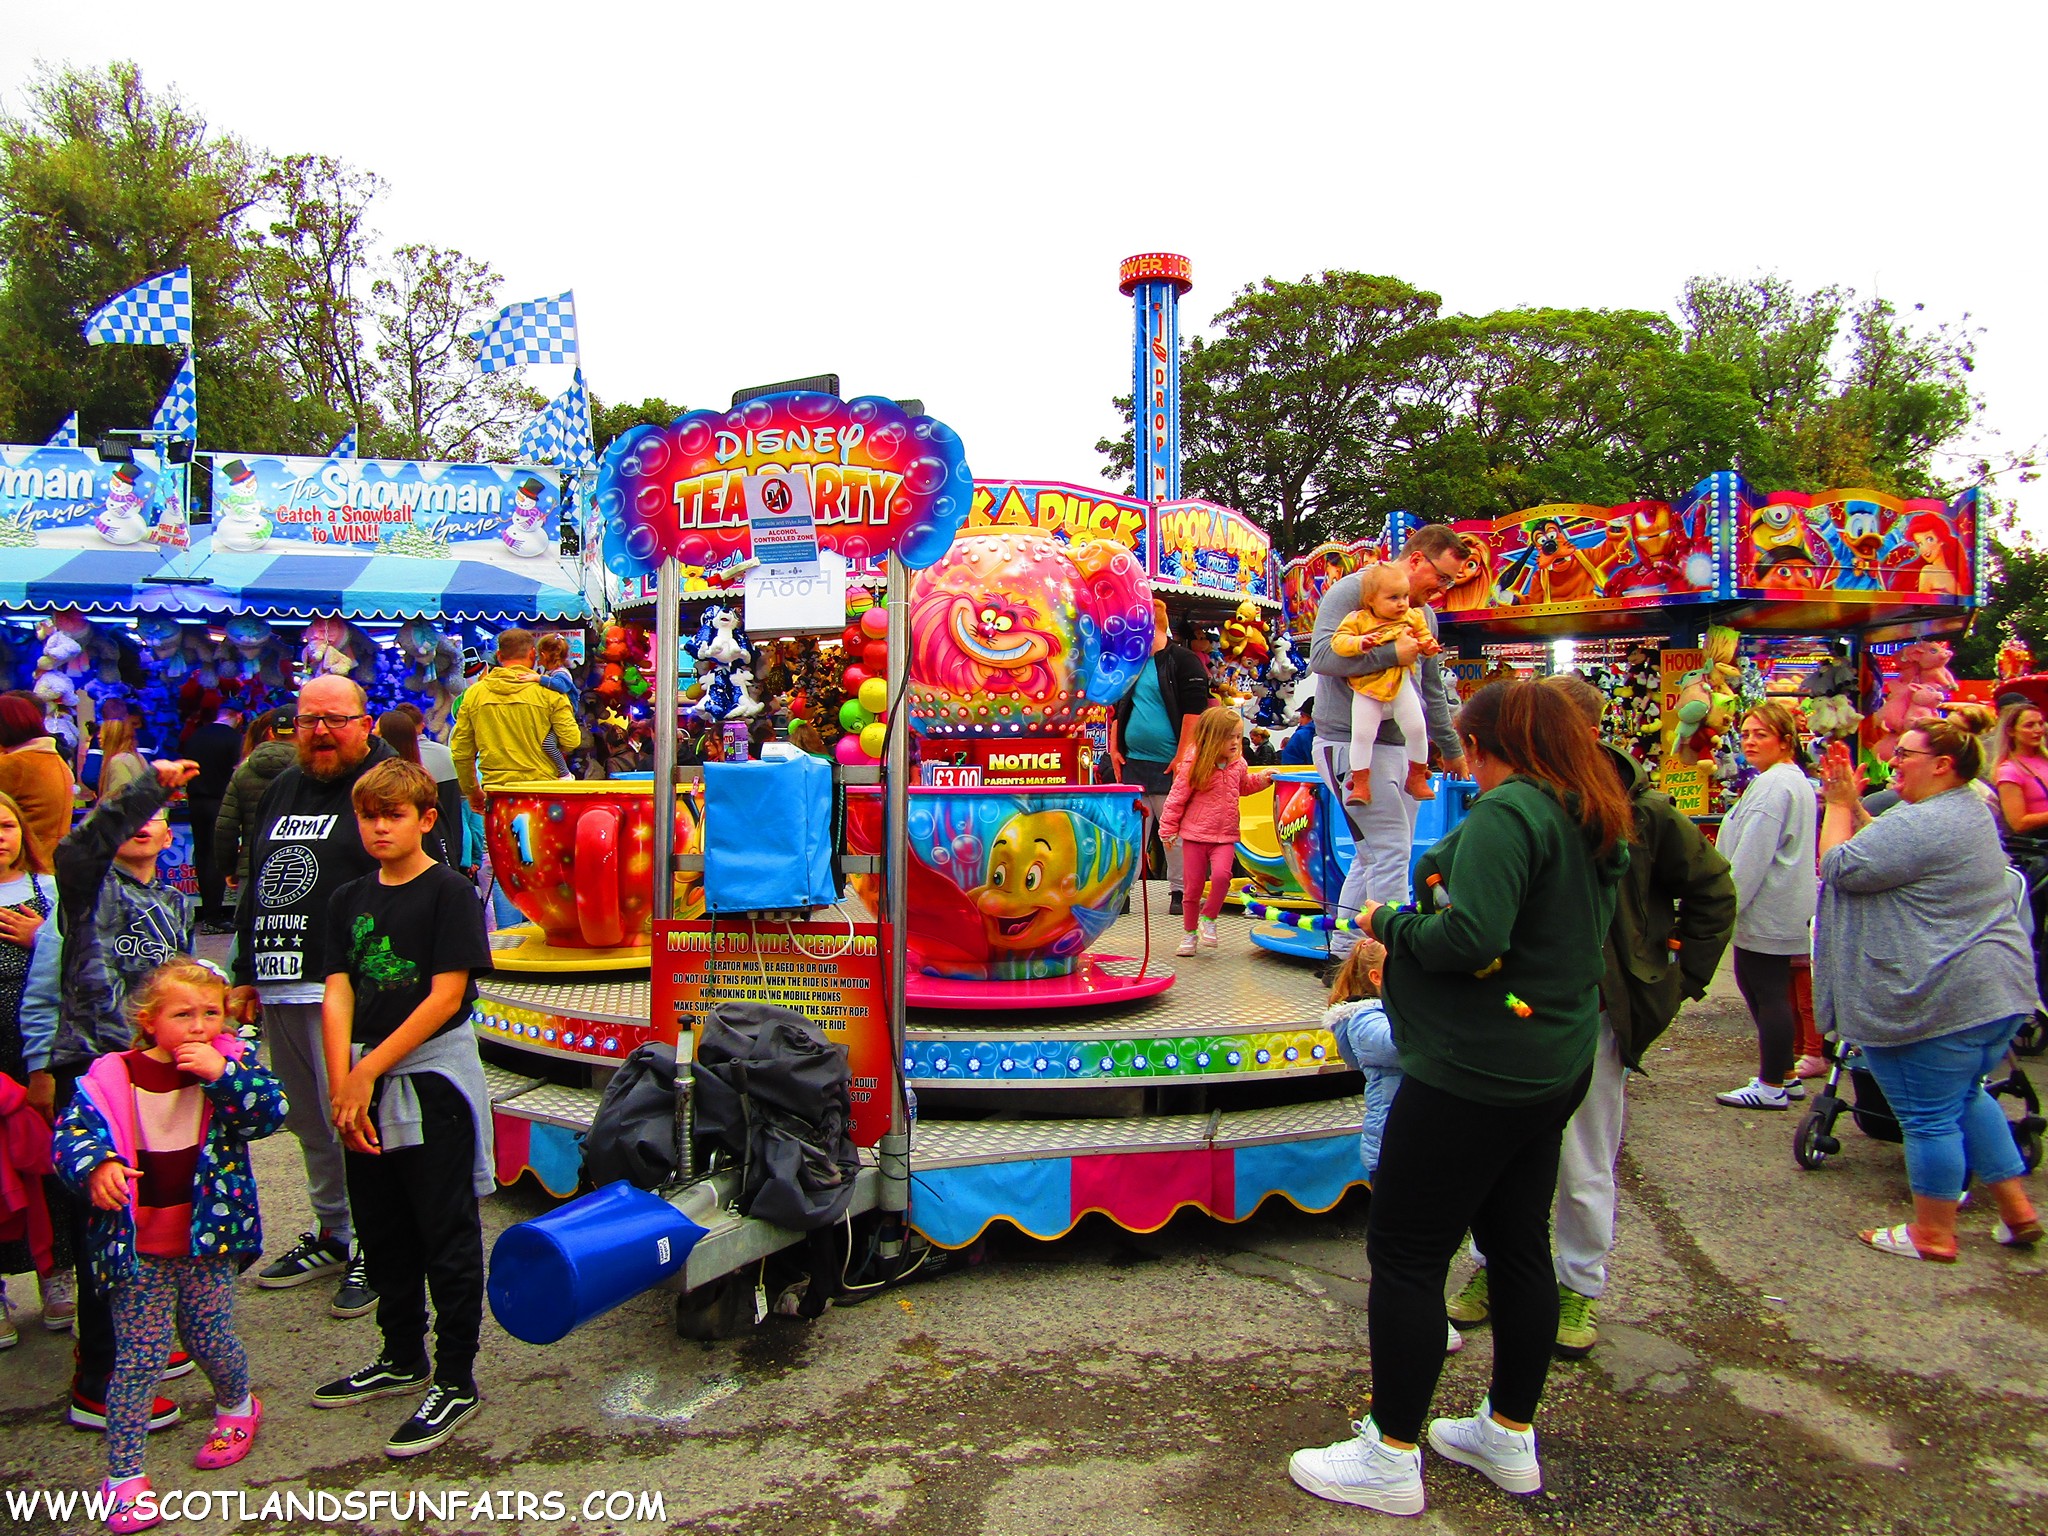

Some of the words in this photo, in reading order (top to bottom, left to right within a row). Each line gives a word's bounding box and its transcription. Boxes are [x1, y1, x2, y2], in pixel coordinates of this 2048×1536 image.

[714, 424, 864, 465] DISNEY
[279, 476, 325, 509] The
[321, 466, 500, 512] Snowman
[674, 474, 750, 529] TEA
[14, 501, 91, 531] Game
[276, 505, 322, 524] Catch
[328, 510, 336, 523] a
[342, 505, 412, 524] Snowball
[995, 486, 1034, 526] A
[1036, 490, 1146, 550] DUCK
[312, 526, 327, 542] to
[332, 524, 380, 544] WIN!!
[430, 515, 498, 545] Game
[754, 535, 796, 543] CONTROLLED
[1160, 507, 1211, 556] HOOK
[1210, 511, 1227, 550] A
[1226, 518, 1269, 578] DUCK
[1208, 555, 1228, 573] PRIZE
[988, 752, 1062, 771] NOTICE
[936, 769, 977, 786] £300
[984, 777, 1024, 786] PARENTS
[1027, 777, 1044, 785] MAY
[1046, 776, 1067, 785] RIDE
[1665, 771, 1697, 784] PRIZE
[1669, 785, 1703, 797] EVERY
[267, 914, 309, 931] FUTURE
[667, 932, 725, 953] NOTICE
[727, 932, 749, 954] TO
[751, 933, 790, 954] RIDE
[792, 934, 877, 956] OPERATOR
[704, 960, 741, 971] OERATOR
[765, 962, 774, 972] BE
[775, 962, 794, 972] AGED
[796, 962, 805, 973] 18
[806, 963, 817, 973] OR
[818, 963, 837, 973] OVER
[673, 973, 683, 983] DO
[685, 973, 699, 984] NOT
[722, 974, 739, 985] THIS
[741, 975, 762, 986] POINT
[787, 976, 801, 987] THE
[802, 977, 820, 988] RIDE
[821, 977, 829, 988] IS
[830, 978, 838, 988] IN
[840, 978, 870, 989] MOTION
[711, 988, 745, 999] SMOKING
[746, 989, 757, 999] OR
[758, 989, 781, 1000] USING
[783, 990, 810, 1001] MOBILE
[812, 991, 841, 1002] PHONES
[673, 1000, 694, 1011] MAKE
[806, 1005, 819, 1016] THE
[820, 1006, 848, 1017] SAFETY
[849, 1006, 869, 1017] ROPE
[828, 1020, 846, 1031] RIDE
[854, 1077, 878, 1089] ADULT
[851, 1092, 871, 1103] STOP
